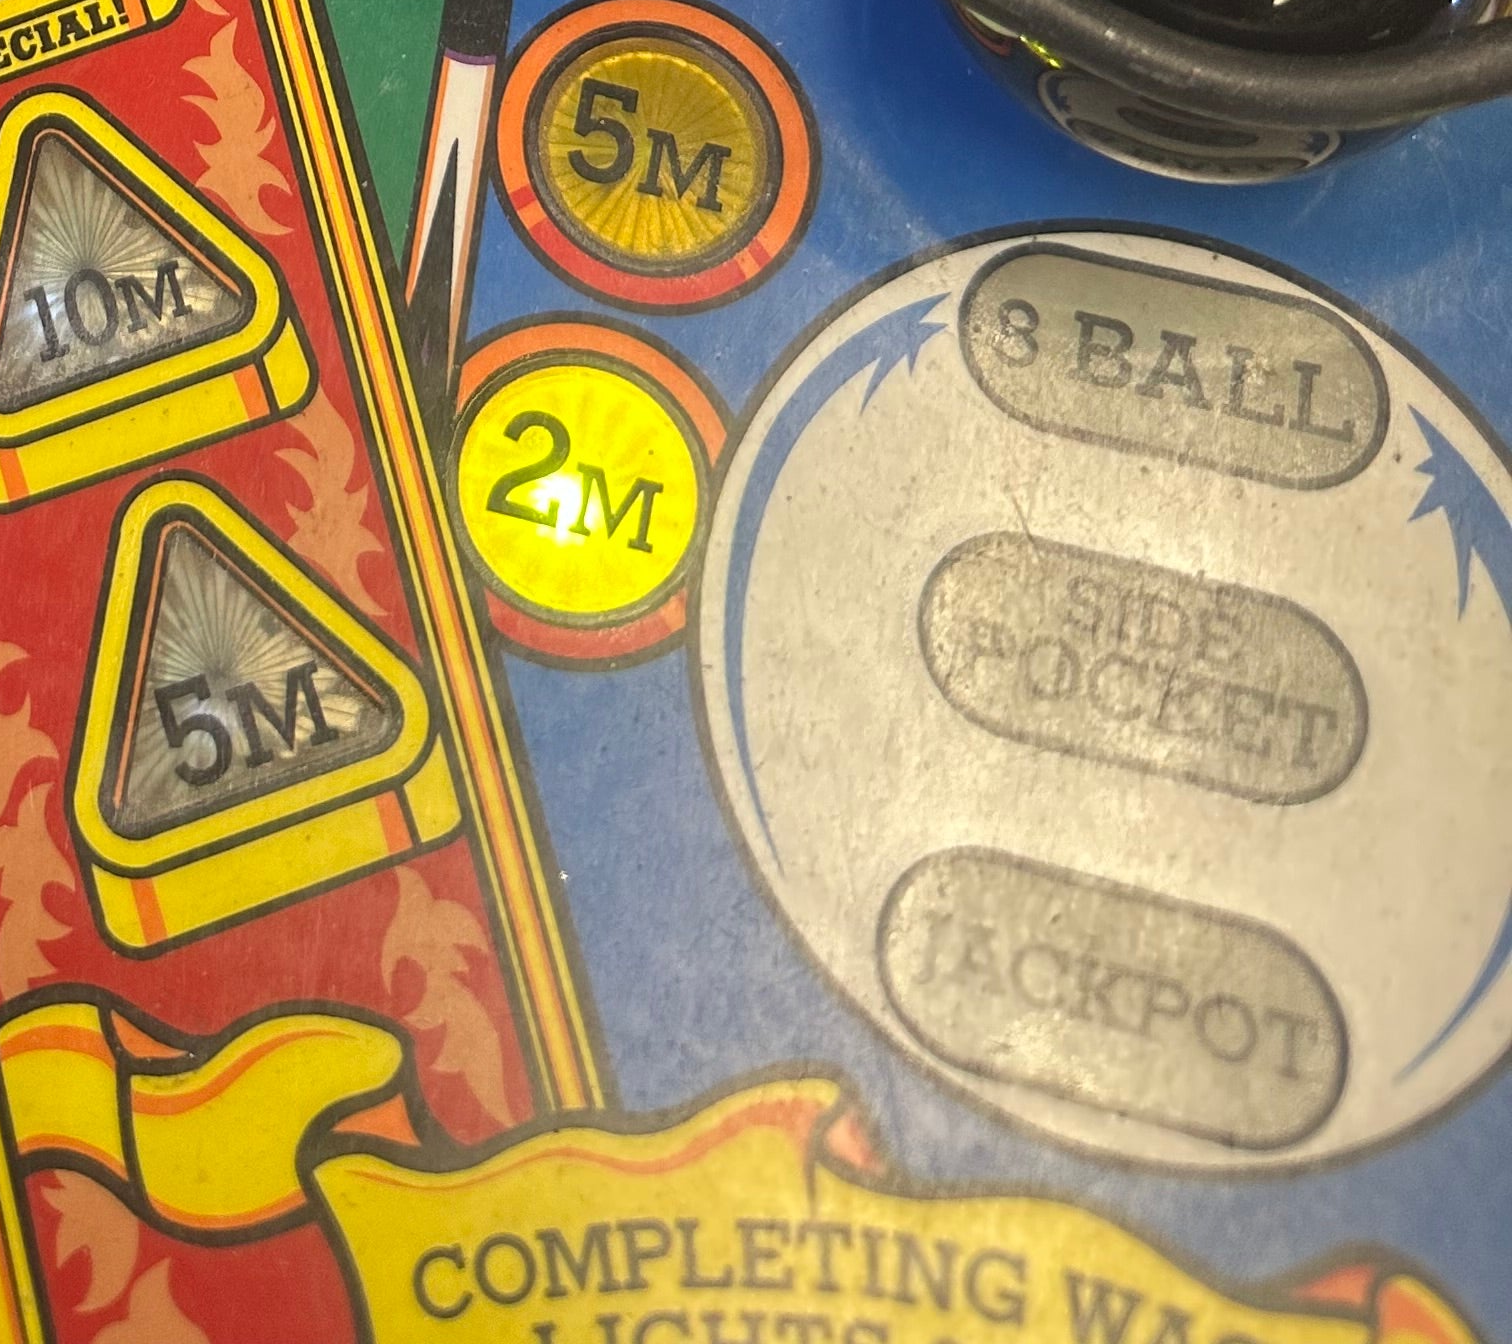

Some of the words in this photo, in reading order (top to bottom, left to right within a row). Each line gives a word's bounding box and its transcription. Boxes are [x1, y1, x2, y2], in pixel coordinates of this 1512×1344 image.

[567, 79, 733, 212] 5M
[24, 259, 193, 363] 10M
[995, 297, 1042, 370] 8
[1073, 311, 1353, 442] BALL
[487, 408, 666, 554] 2M
[1067, 575, 1247, 660] SIDE
[154, 660, 339, 787] 5M
[967, 620, 1338, 772] POCKET
[917, 915, 1323, 1081] JACKPOT
[412, 1214, 1028, 1327] COMPLETING
